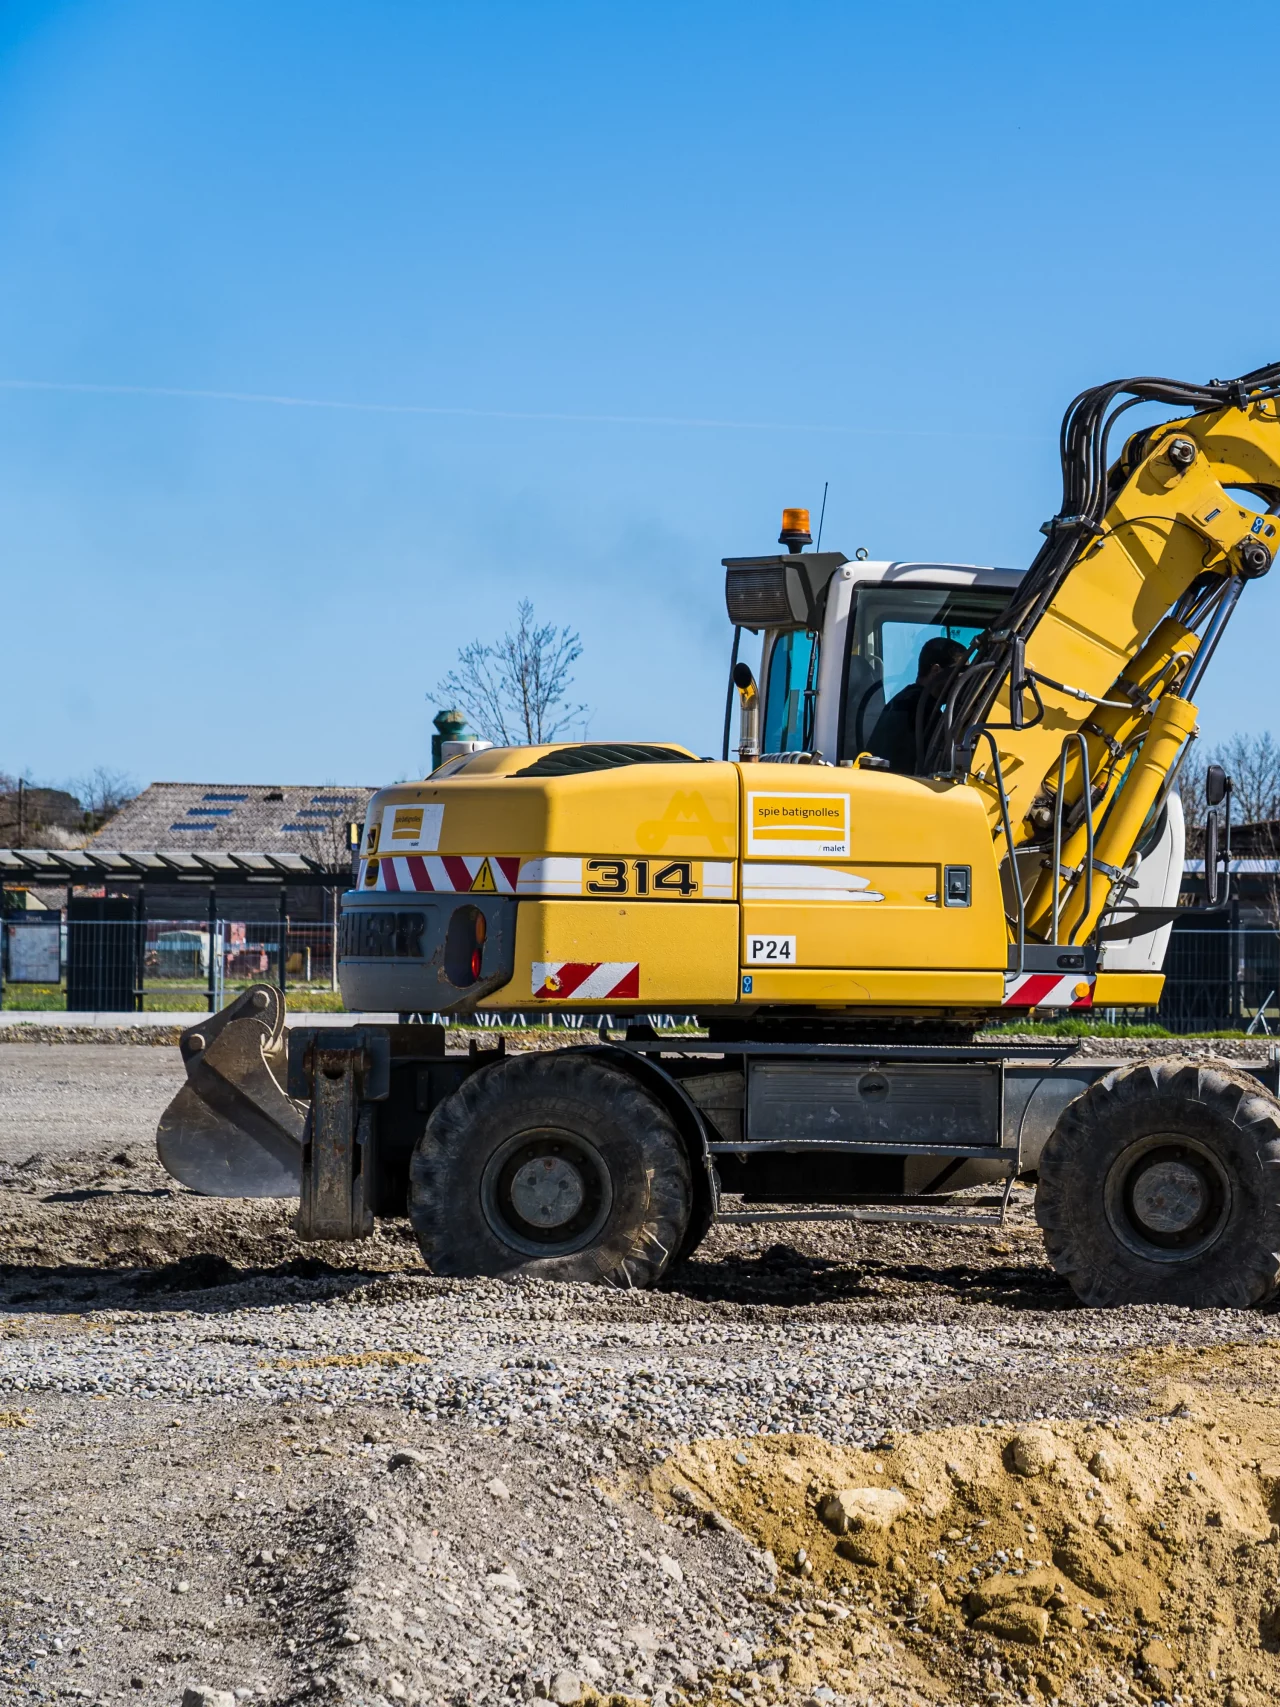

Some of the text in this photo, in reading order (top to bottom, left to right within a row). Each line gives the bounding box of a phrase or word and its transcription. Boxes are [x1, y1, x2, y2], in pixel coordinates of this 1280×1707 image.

[758, 807, 840, 819] spie batignolles
[586, 858, 698, 897] 314
[752, 940, 791, 959] P24
